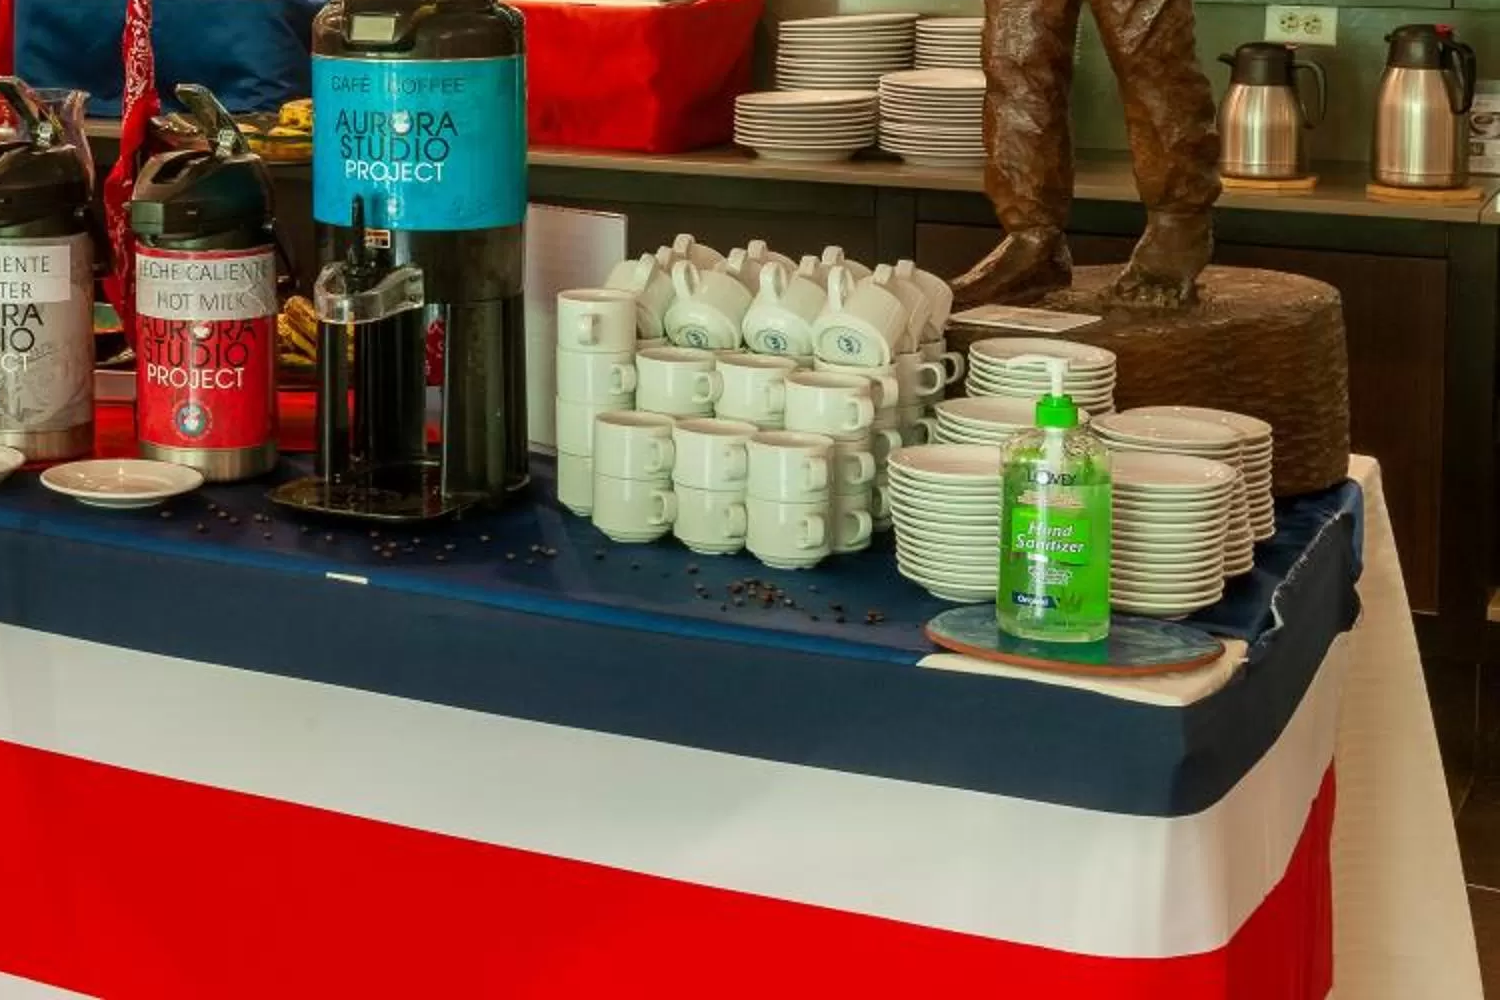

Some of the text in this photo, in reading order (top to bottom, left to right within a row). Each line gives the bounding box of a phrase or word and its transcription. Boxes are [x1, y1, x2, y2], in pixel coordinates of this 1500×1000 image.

[335, 108, 458, 136] AURORA
[340, 134, 450, 162] STUDIO
[345, 160, 444, 182] PROJECT
[157, 290, 246, 311] HOT MILK
[141, 317, 256, 342] AURORA
[145, 338, 249, 368] STUDIO
[147, 363, 244, 389] PROJECT
